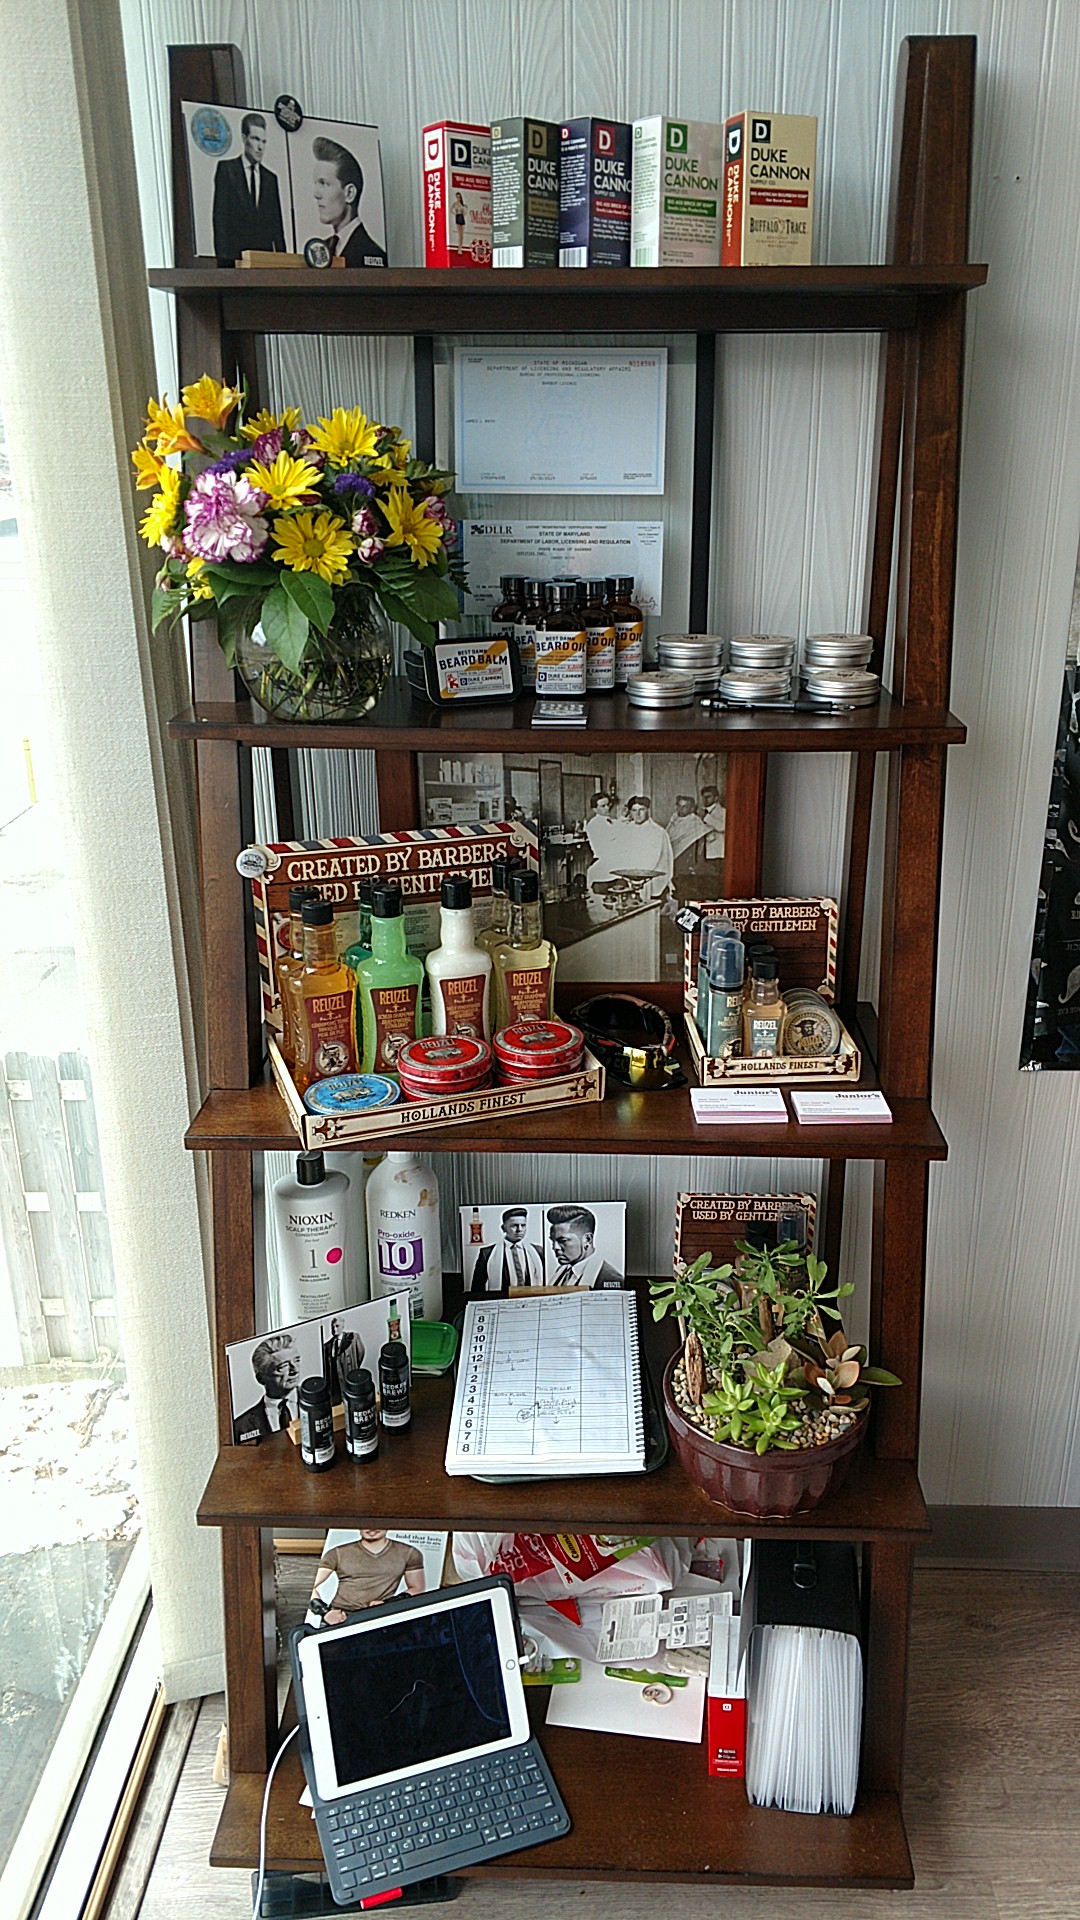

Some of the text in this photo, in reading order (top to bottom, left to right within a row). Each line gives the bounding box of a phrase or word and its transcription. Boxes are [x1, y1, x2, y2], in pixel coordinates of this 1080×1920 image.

[670, 128, 684, 148] D
[755, 122, 768, 139] D
[533, 130, 543, 148] D
[599, 130, 612, 150] D
[729, 129, 740, 155] D
[454, 143, 467, 162] D
[751, 148, 788, 164] DUKE
[473, 156, 490, 166] CAN
[528, 158, 556, 176] DUKE
[594, 158, 625, 176] DUKE
[665, 156, 699, 174] DUKE
[750, 164, 810, 181] CANNON
[527, 175, 558, 192] CANN
[593, 176, 632, 192] CANNO
[664, 173, 718, 191] CANNON
[516, 636, 534, 644] BEA
[536, 642, 569, 651] BEARD
[439, 654, 508, 670] BEARD BALM
[287, 855, 380, 882] CREATED
[385, 846, 412, 872] BY
[418, 842, 507, 869] BARBERS
[752, 906, 767, 918] BY
[769, 907, 820, 918] BARBERS
[750, 920, 816, 931] GENTLEMEN
[448, 979, 478, 995] REUZEL
[513, 972, 543, 986] REUZEL
[313, 995, 346, 1013] REUZEL
[380, 989, 411, 1005] REUZEL
[512, 1024, 548, 1034] REUZEL
[754, 1020, 777, 1030] REUZEL
[420, 1039, 458, 1049] REUZEL
[741, 1061, 819, 1070] HOLLANDS FINEST
[401, 1093, 526, 1123] HOLLANDS FINEST
[690, 1200, 800, 1211] CREATED BY BARBERS
[289, 1212, 334, 1225] NIOXIN
[380, 1210, 416, 1219] REDKEN
[692, 1211, 717, 1220] USED
[720, 1210, 734, 1220] BY
[378, 1229, 415, 1238] Pro-oxide
[310, 1249, 318, 1269] 1
[379, 1241, 414, 1270] 10
[354, 1406, 376, 1417] REDK
[354, 1413, 374, 1424] BREW
[466, 1407, 474, 1415] 5
[465, 1420, 472, 1428] 6
[464, 1432, 471, 1440] 7
[462, 1444, 470, 1452] 8
